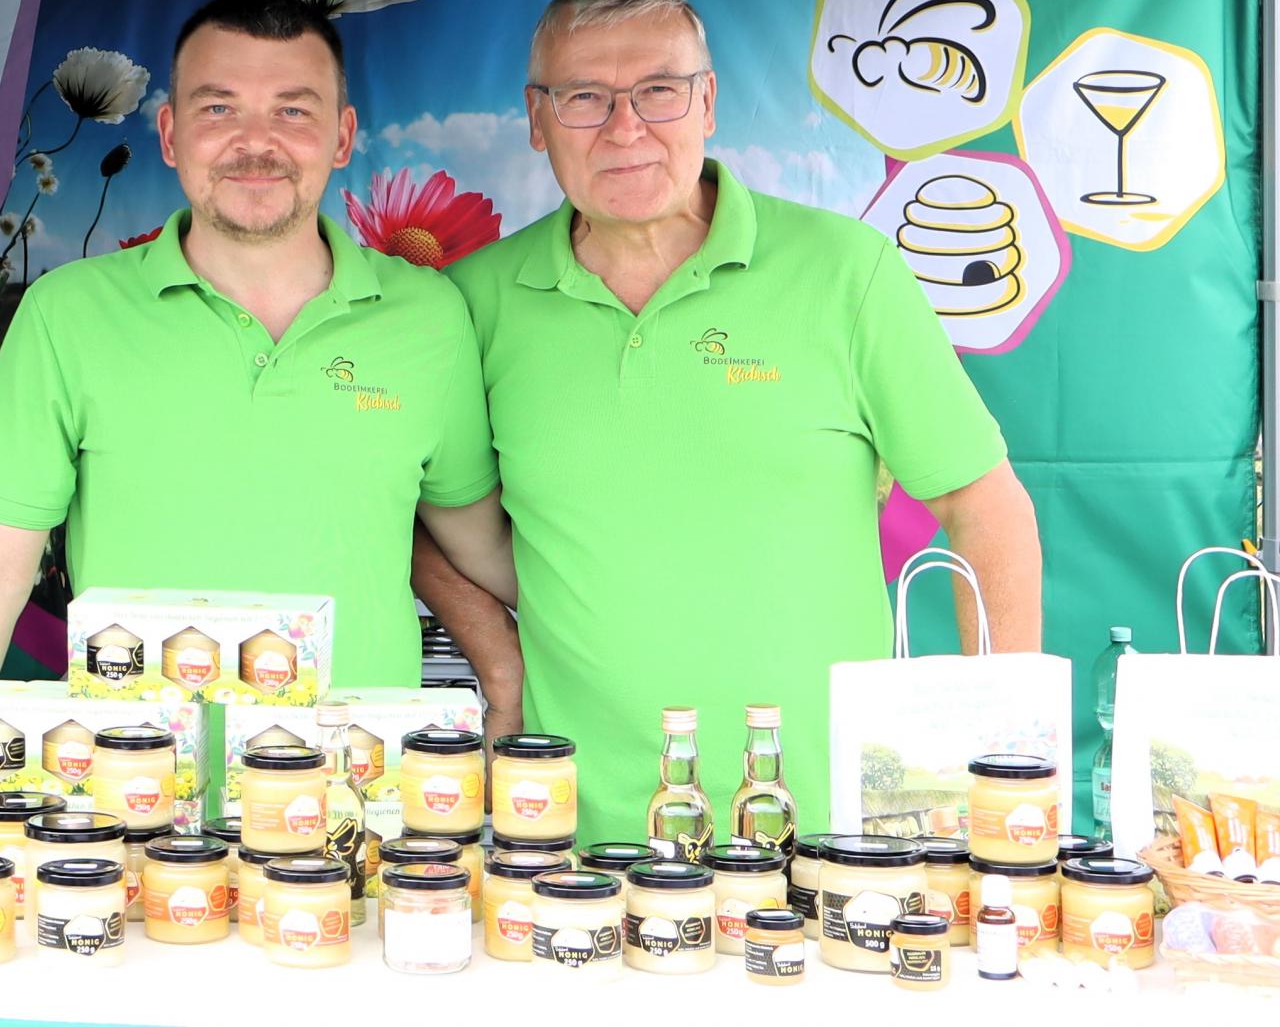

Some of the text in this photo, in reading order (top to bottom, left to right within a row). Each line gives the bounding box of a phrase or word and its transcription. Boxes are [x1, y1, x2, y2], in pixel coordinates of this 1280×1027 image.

[516, 801, 544, 809] HONIG
[291, 819, 317, 827] HONIG
[501, 923, 529, 931] HONIG
[857, 929, 894, 938] HONIG
[71, 938, 100, 946] HONIG
[645, 940, 673, 948] HONIG
[865, 939, 879, 948] 500
[1098, 936, 1128, 944] HONIG
[558, 951, 588, 959] HONIG
